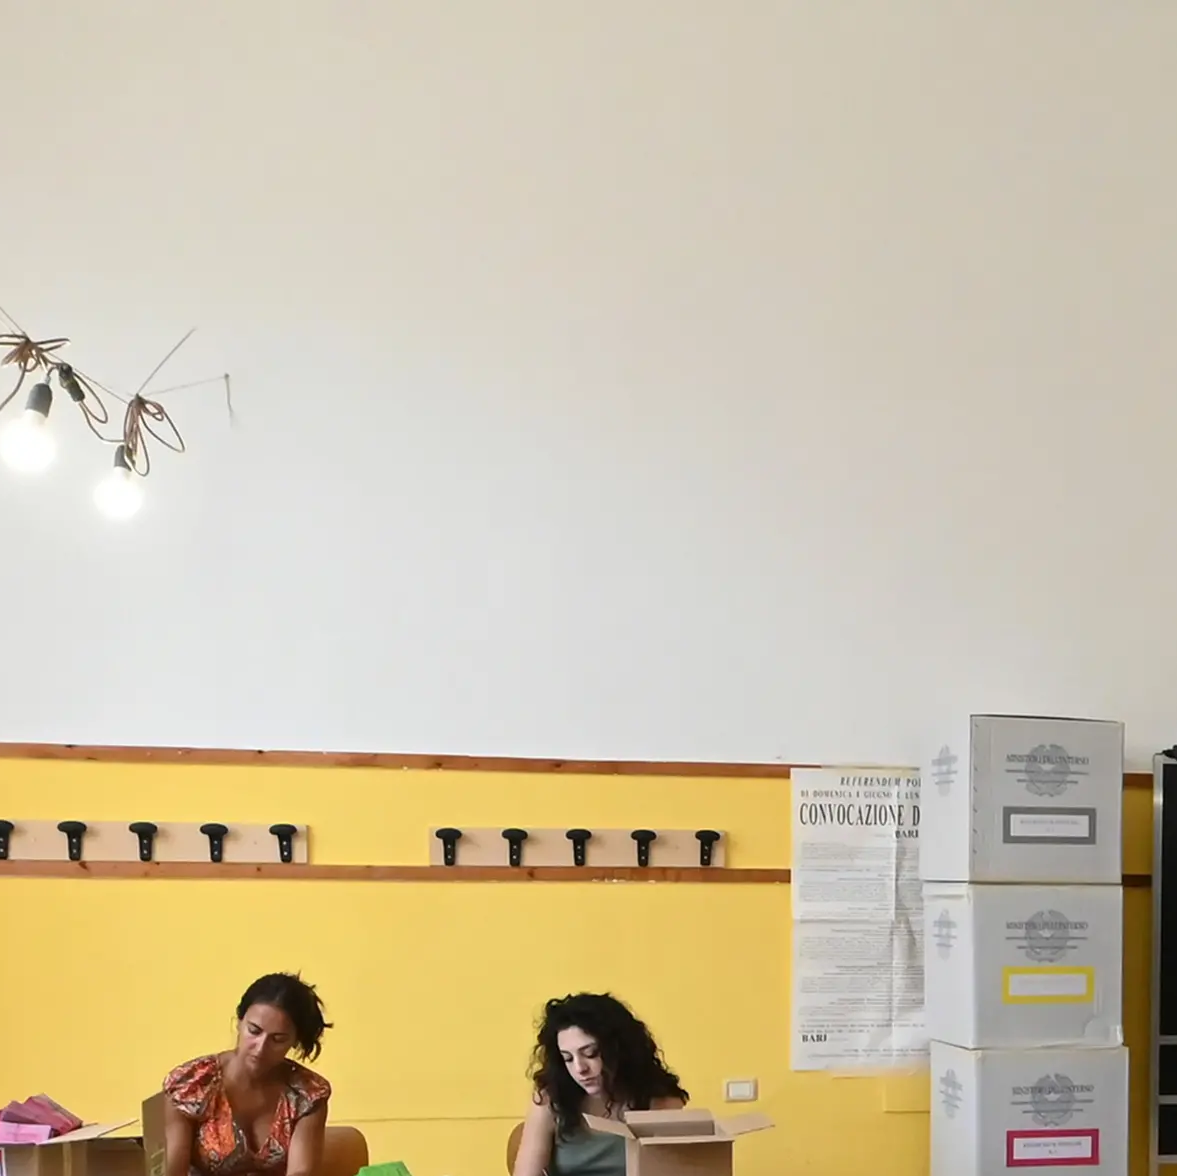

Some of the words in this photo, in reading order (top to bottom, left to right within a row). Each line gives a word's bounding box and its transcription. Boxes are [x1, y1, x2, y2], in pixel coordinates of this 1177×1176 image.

[840, 777, 901, 787] REFERENDUM
[813, 790, 852, 799] DOMENICA
[864, 791, 893, 799] GIUGNO
[799, 803, 905, 826] CONVOCAZIONE
[895, 830, 920, 839] BARI
[801, 1033, 827, 1043] BARI
